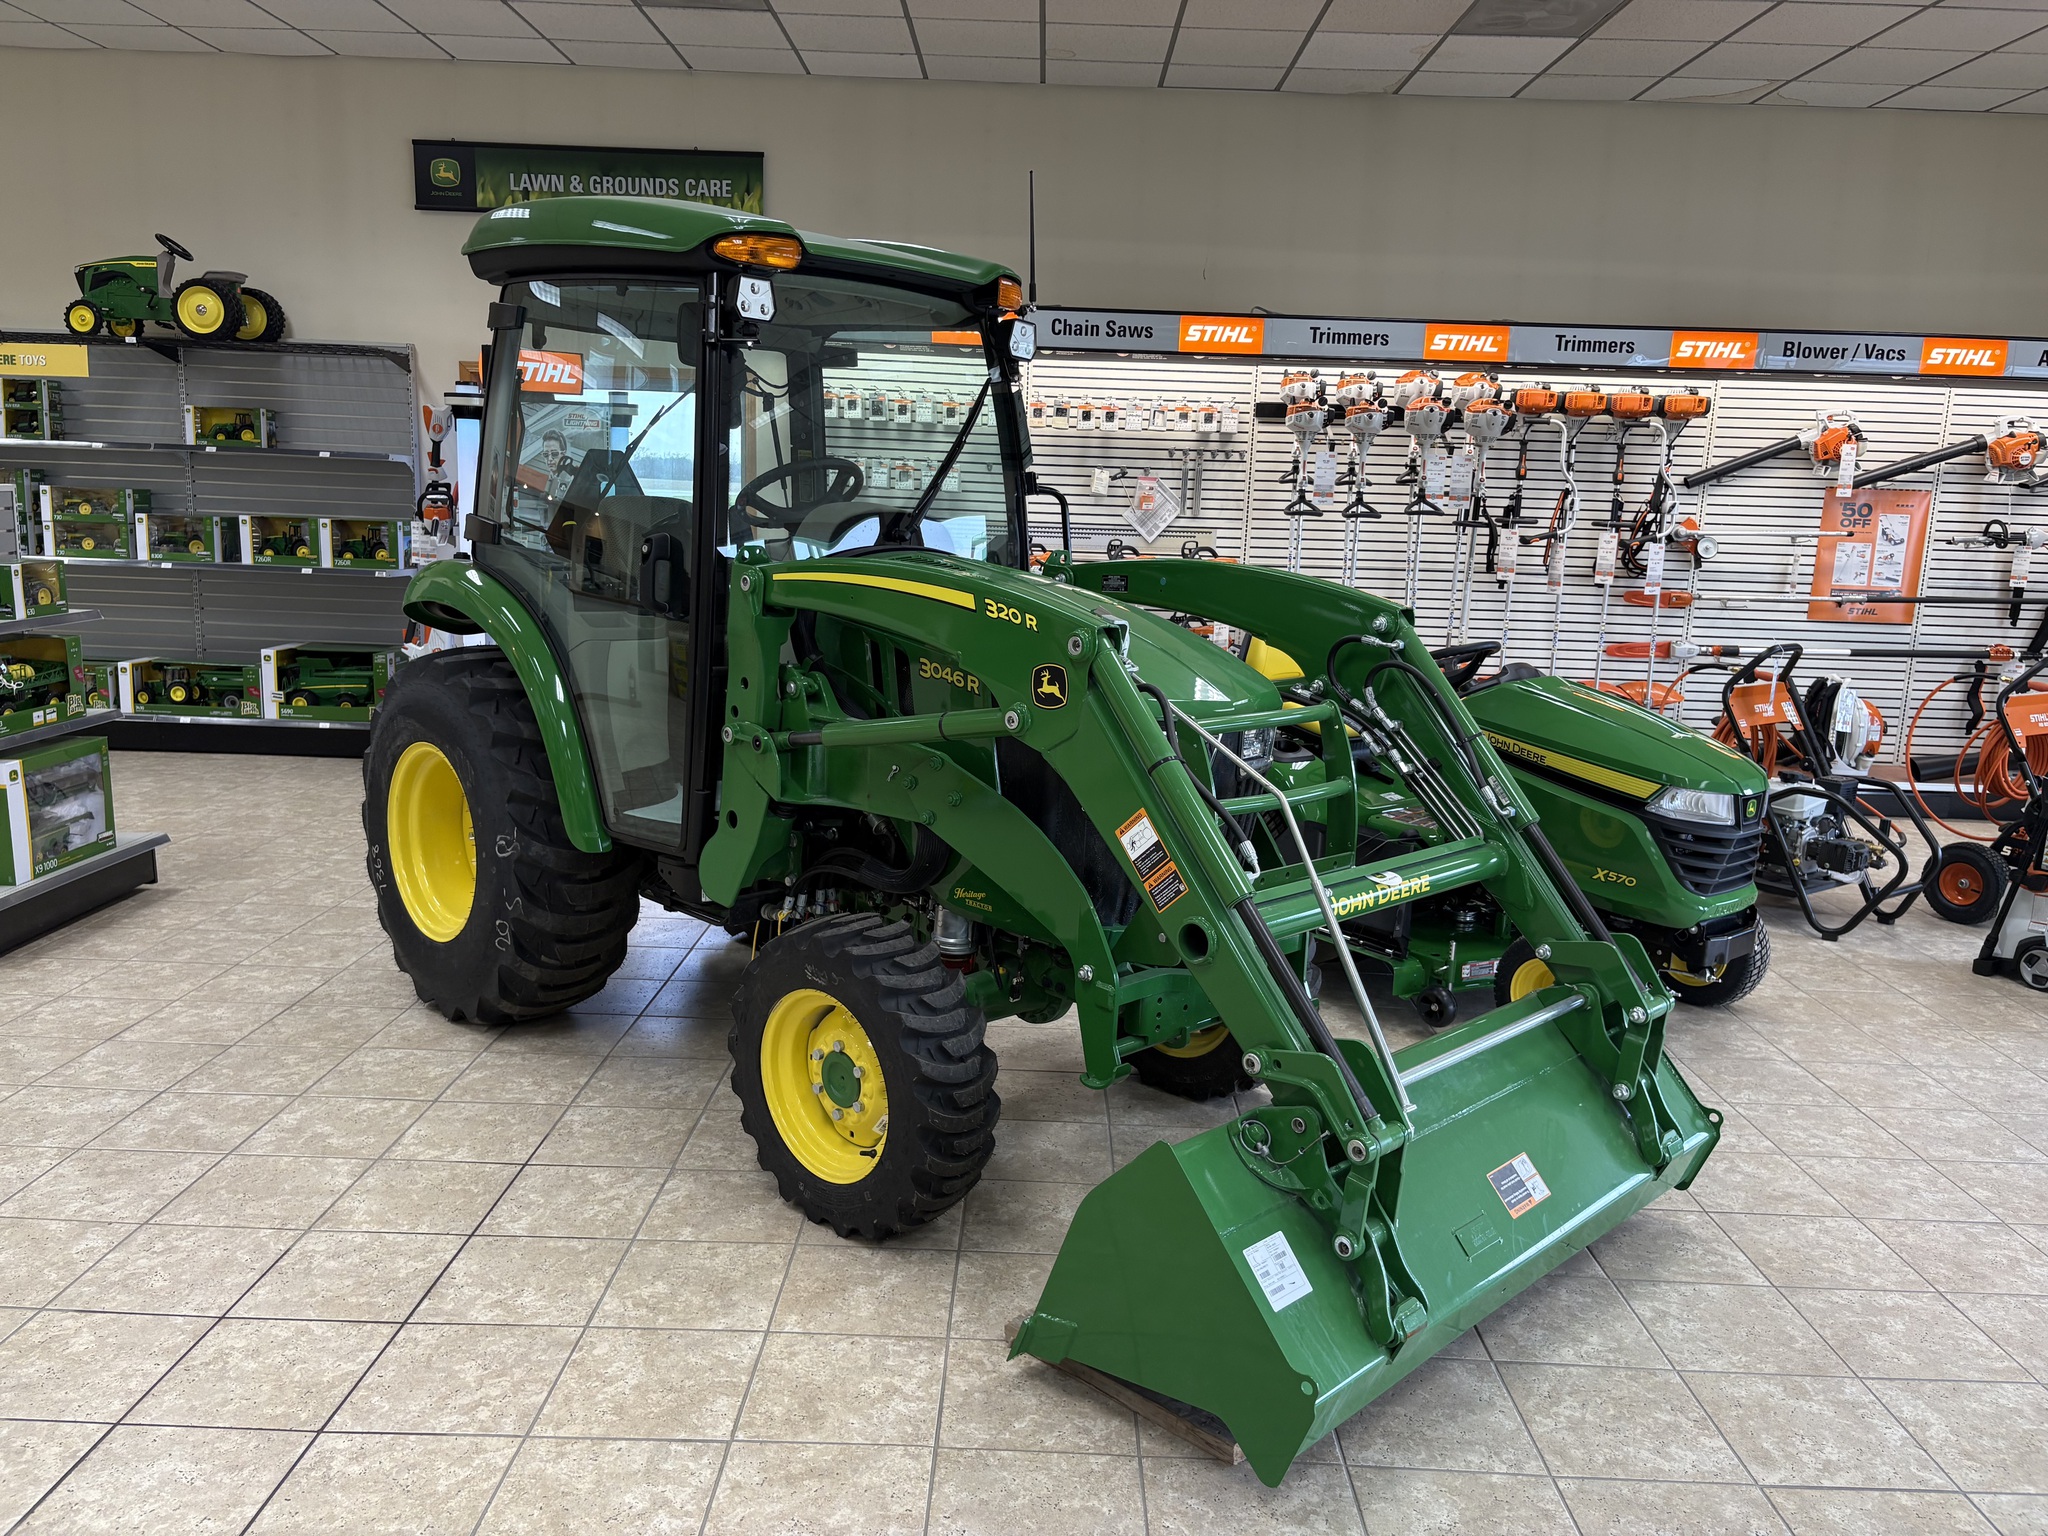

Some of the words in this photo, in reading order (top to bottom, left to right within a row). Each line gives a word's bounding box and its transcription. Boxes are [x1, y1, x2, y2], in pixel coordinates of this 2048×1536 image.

[509, 173, 564, 192] LAWN
[569, 175, 584, 193] &
[589, 176, 679, 196] GROUNDS
[685, 178, 732, 198] CARE
[1051, 318, 1100, 337] Chain
[1105, 320, 1154, 339] Saws
[1185, 325, 1253, 343] STIHL
[1309, 327, 1390, 346] Trimmers
[1430, 334, 1499, 352] STIHL
[1555, 334, 1635, 354] Trimmers
[1676, 341, 1746, 359] STIHL
[1783, 341, 1848, 360] Blower
[1850, 343, 1861, 362] /
[1865, 343, 1906, 362] Vacs
[19, 354, 47, 366] TOYS
[1926, 348, 1996, 366] STIHL
[1840, 518, 1872, 528] OFF
[984, 598, 1022, 625] 320
[1025, 613, 1039, 633] R
[1847, 607, 1878, 615] STIHL
[919, 657, 965, 688] 3046
[967, 674, 980, 695] R
[1487, 733, 1511, 751] JOHN
[1513, 743, 1547, 764] DEERE
[1123, 812, 1143, 831] WARNING
[35, 863, 44, 875] X9
[44, 858, 58, 871] 1000
[1153, 866, 1173, 885] WARNING
[1592, 867, 1637, 888] X570
[953, 887, 987, 900] Heritage
[1330, 889, 1374, 916] JOHN
[1376, 874, 1431, 905] DEERE
